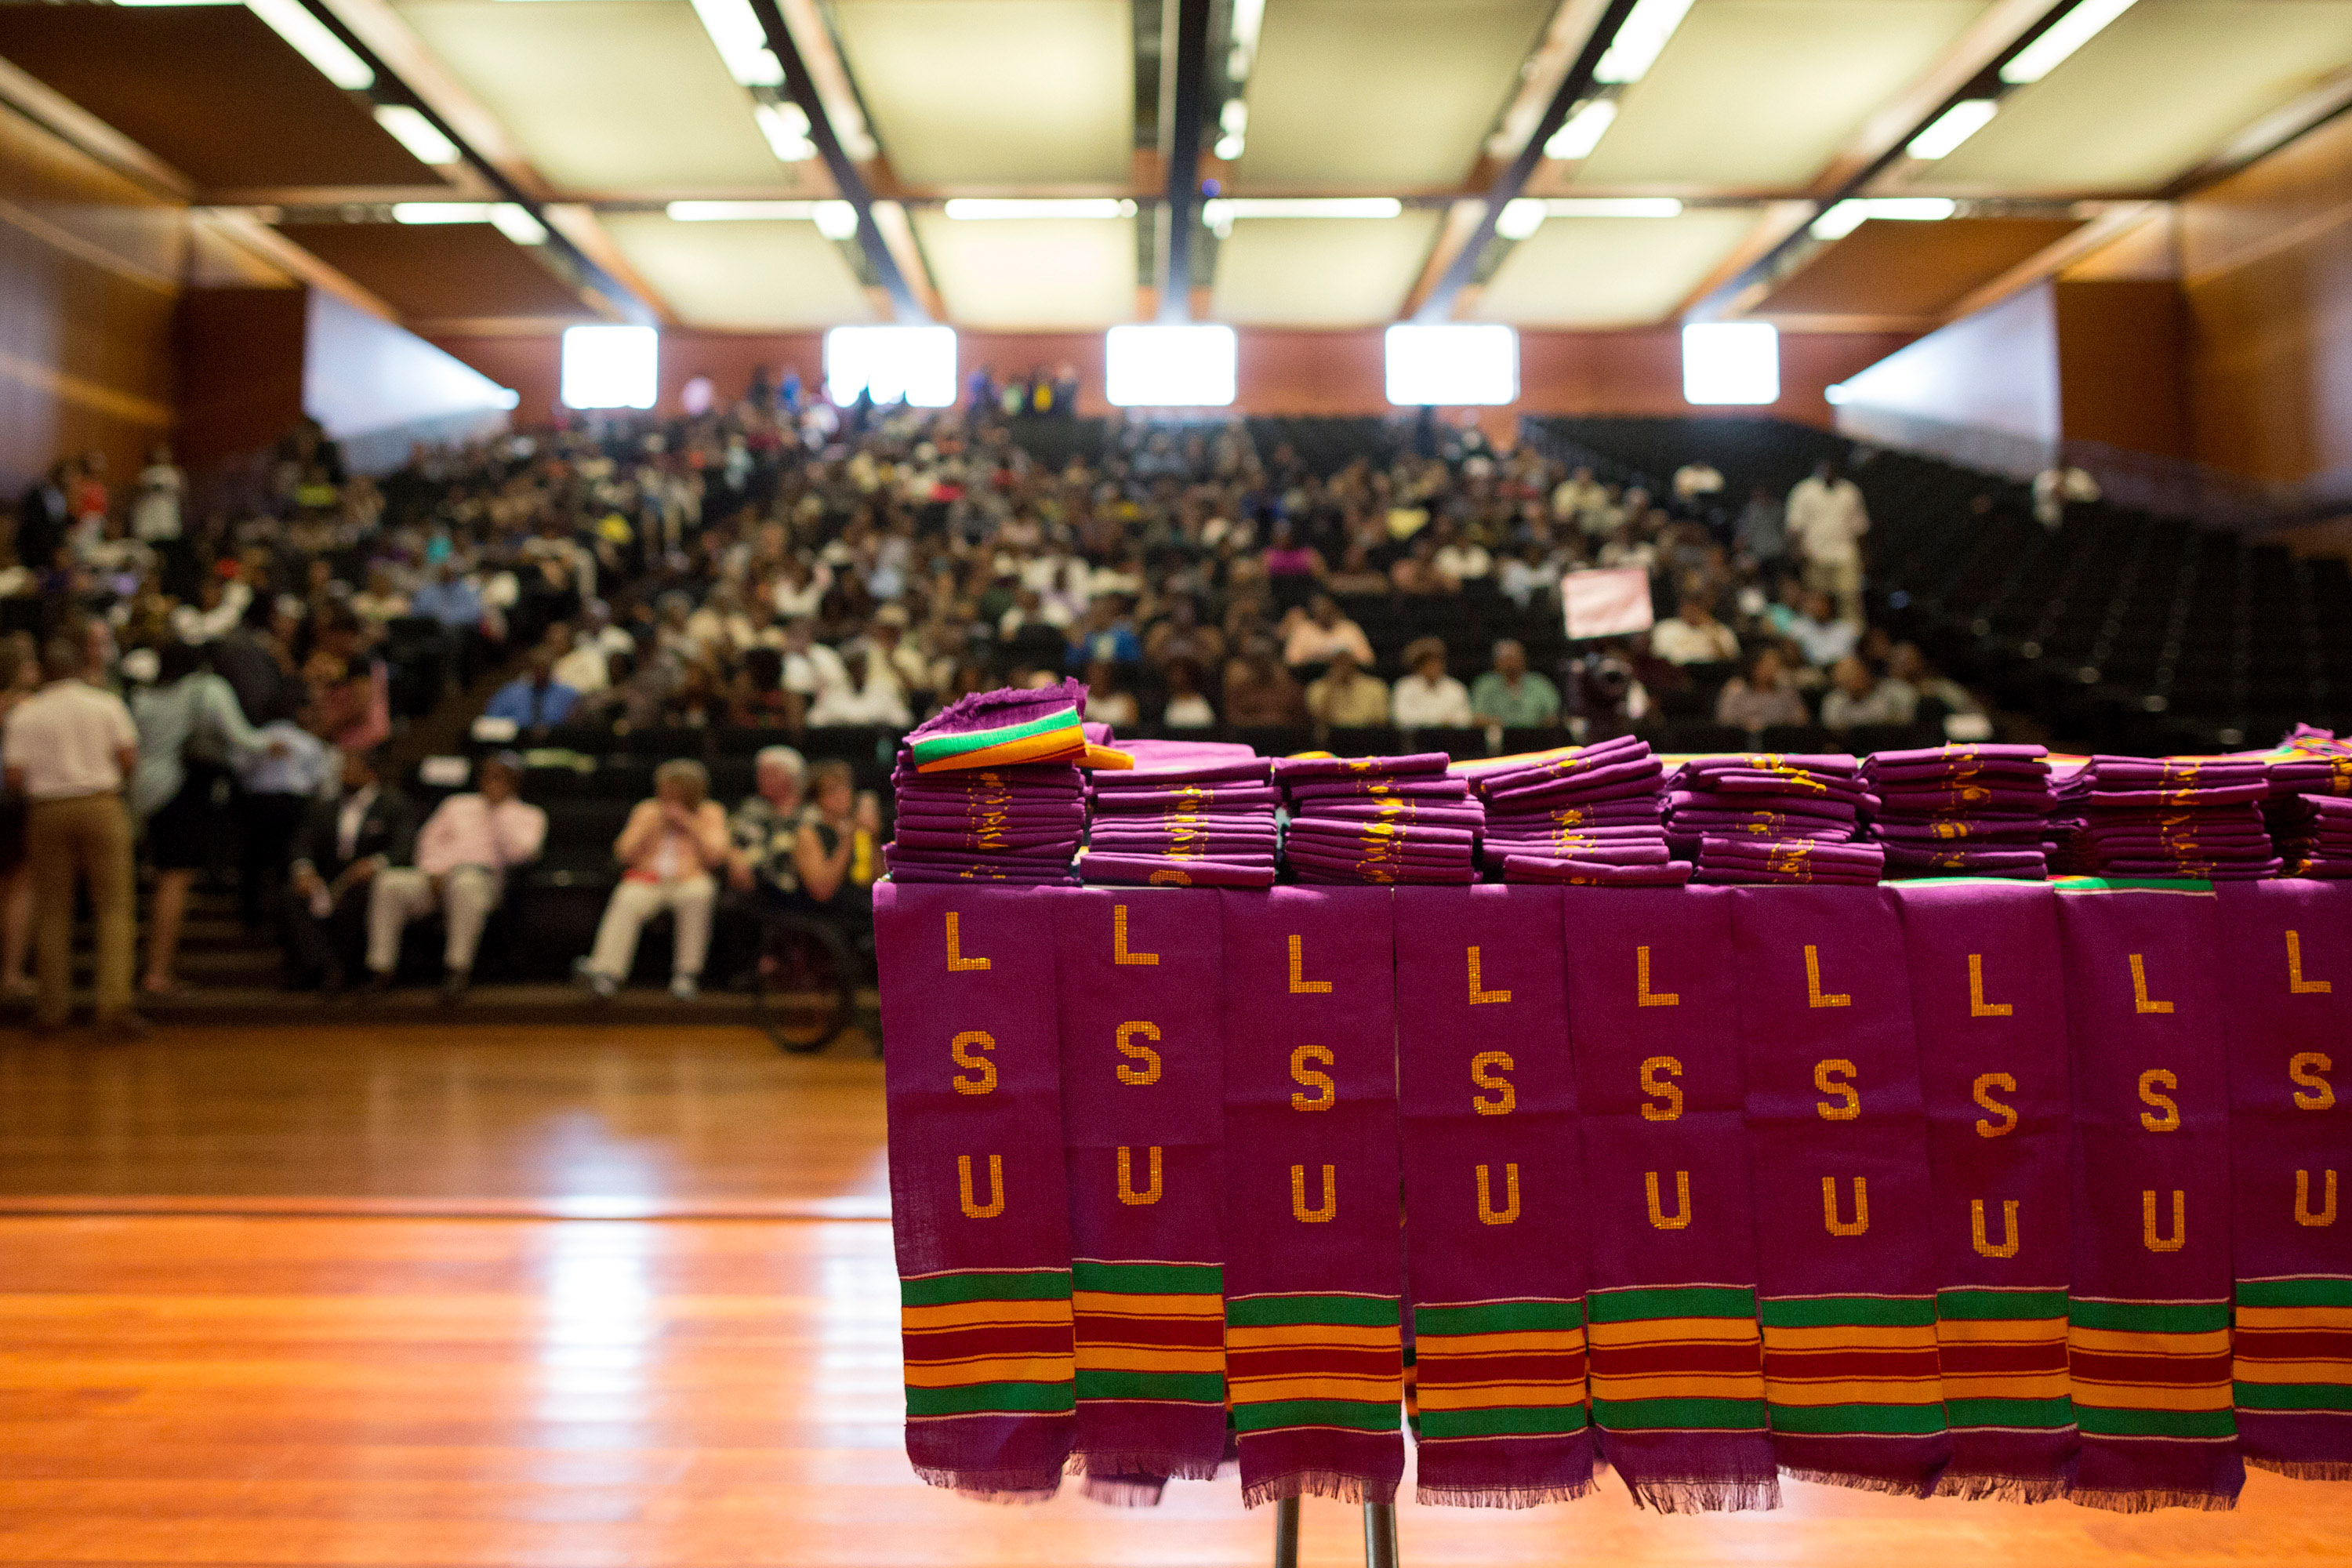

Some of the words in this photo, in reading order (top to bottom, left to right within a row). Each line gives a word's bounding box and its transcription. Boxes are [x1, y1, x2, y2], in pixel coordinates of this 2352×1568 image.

[946, 912, 1004, 1218] LSU
[1115, 906, 1162, 1205] LSU
[1289, 935, 1336, 1222] LSU
[1468, 946, 1519, 1225] LSU
[1638, 946, 1690, 1229] LSU
[1805, 946, 1868, 1236] LSU
[1969, 954, 2019, 1258] LSU
[2129, 954, 2184, 1252] LSU
[2286, 931, 2336, 1226] LSU
